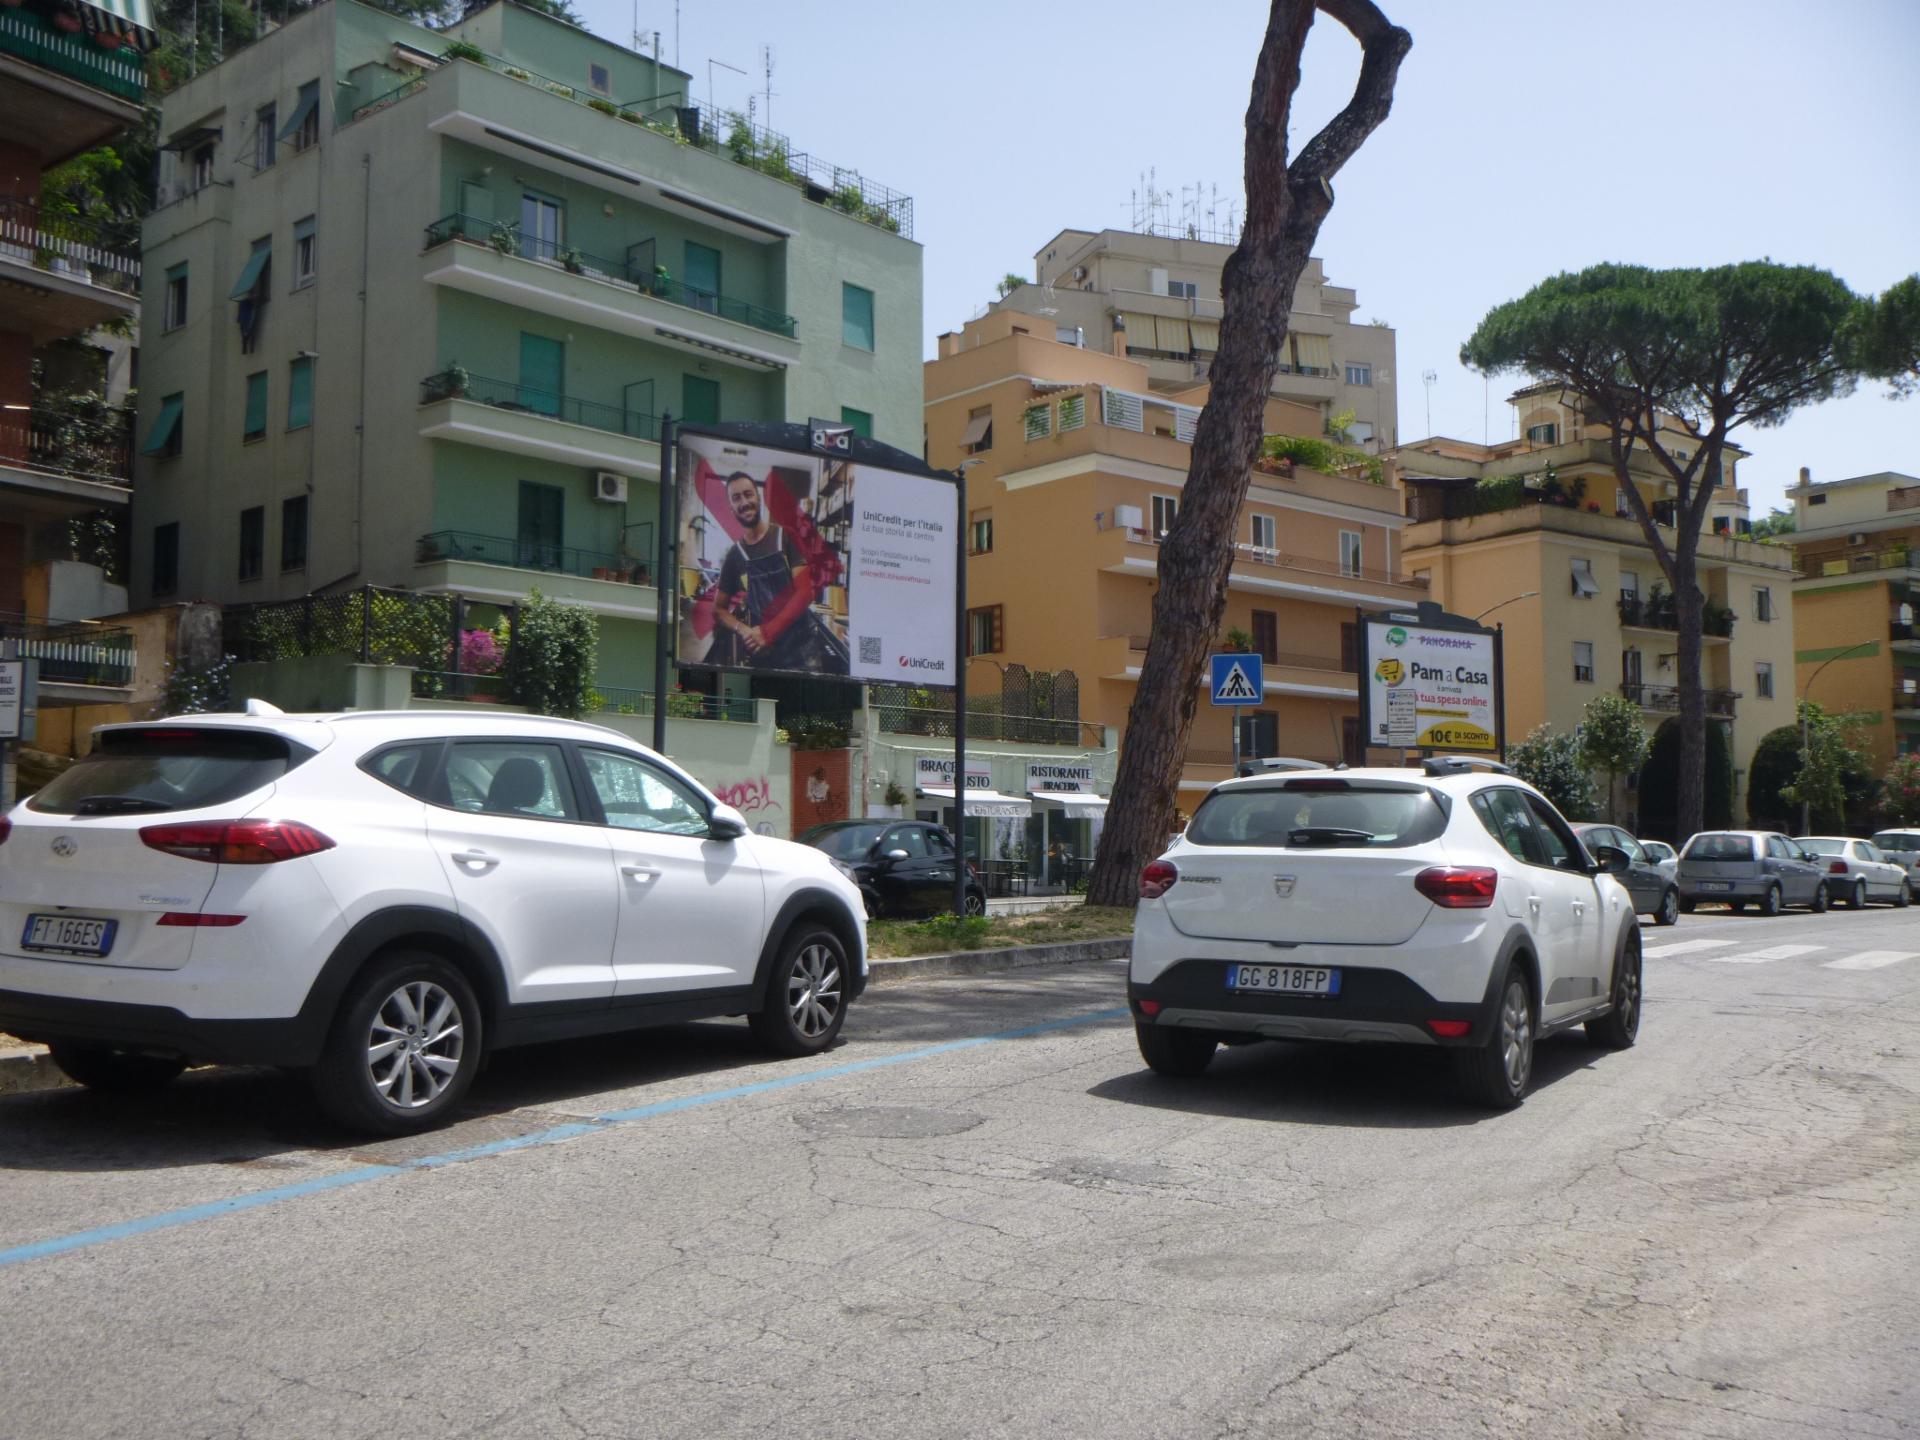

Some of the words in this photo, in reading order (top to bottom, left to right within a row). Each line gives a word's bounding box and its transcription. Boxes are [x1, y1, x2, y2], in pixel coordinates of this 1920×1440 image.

[863, 511, 901, 526] UniCredit
[903, 519, 916, 529] per
[918, 519, 943, 533] l'Italia
[862, 523, 871, 533] La
[873, 525, 884, 535] tua
[885, 527, 905, 537] storia
[914, 532, 935, 542] centro
[1420, 635, 1473, 650] PANORAMA
[909, 657, 945, 671] UniCredit
[1410, 662, 1444, 682] Pam
[1446, 670, 1453, 683] a
[1455, 666, 1489, 685] Casa
[1420, 693, 1436, 704] tua
[1437, 696, 1461, 707] spesa
[1462, 696, 1488, 708] online
[1428, 729, 1452, 744] 10€
[1463, 732, 1490, 741] SCONTO
[1031, 766, 1092, 780] RISTORANTE
[1042, 781, 1081, 792] BRACERIA
[31, 917, 53, 942] FT
[55, 920, 104, 947] 166ES
[1238, 966, 1261, 987] GG
[1267, 968, 1328, 990] 818FP
